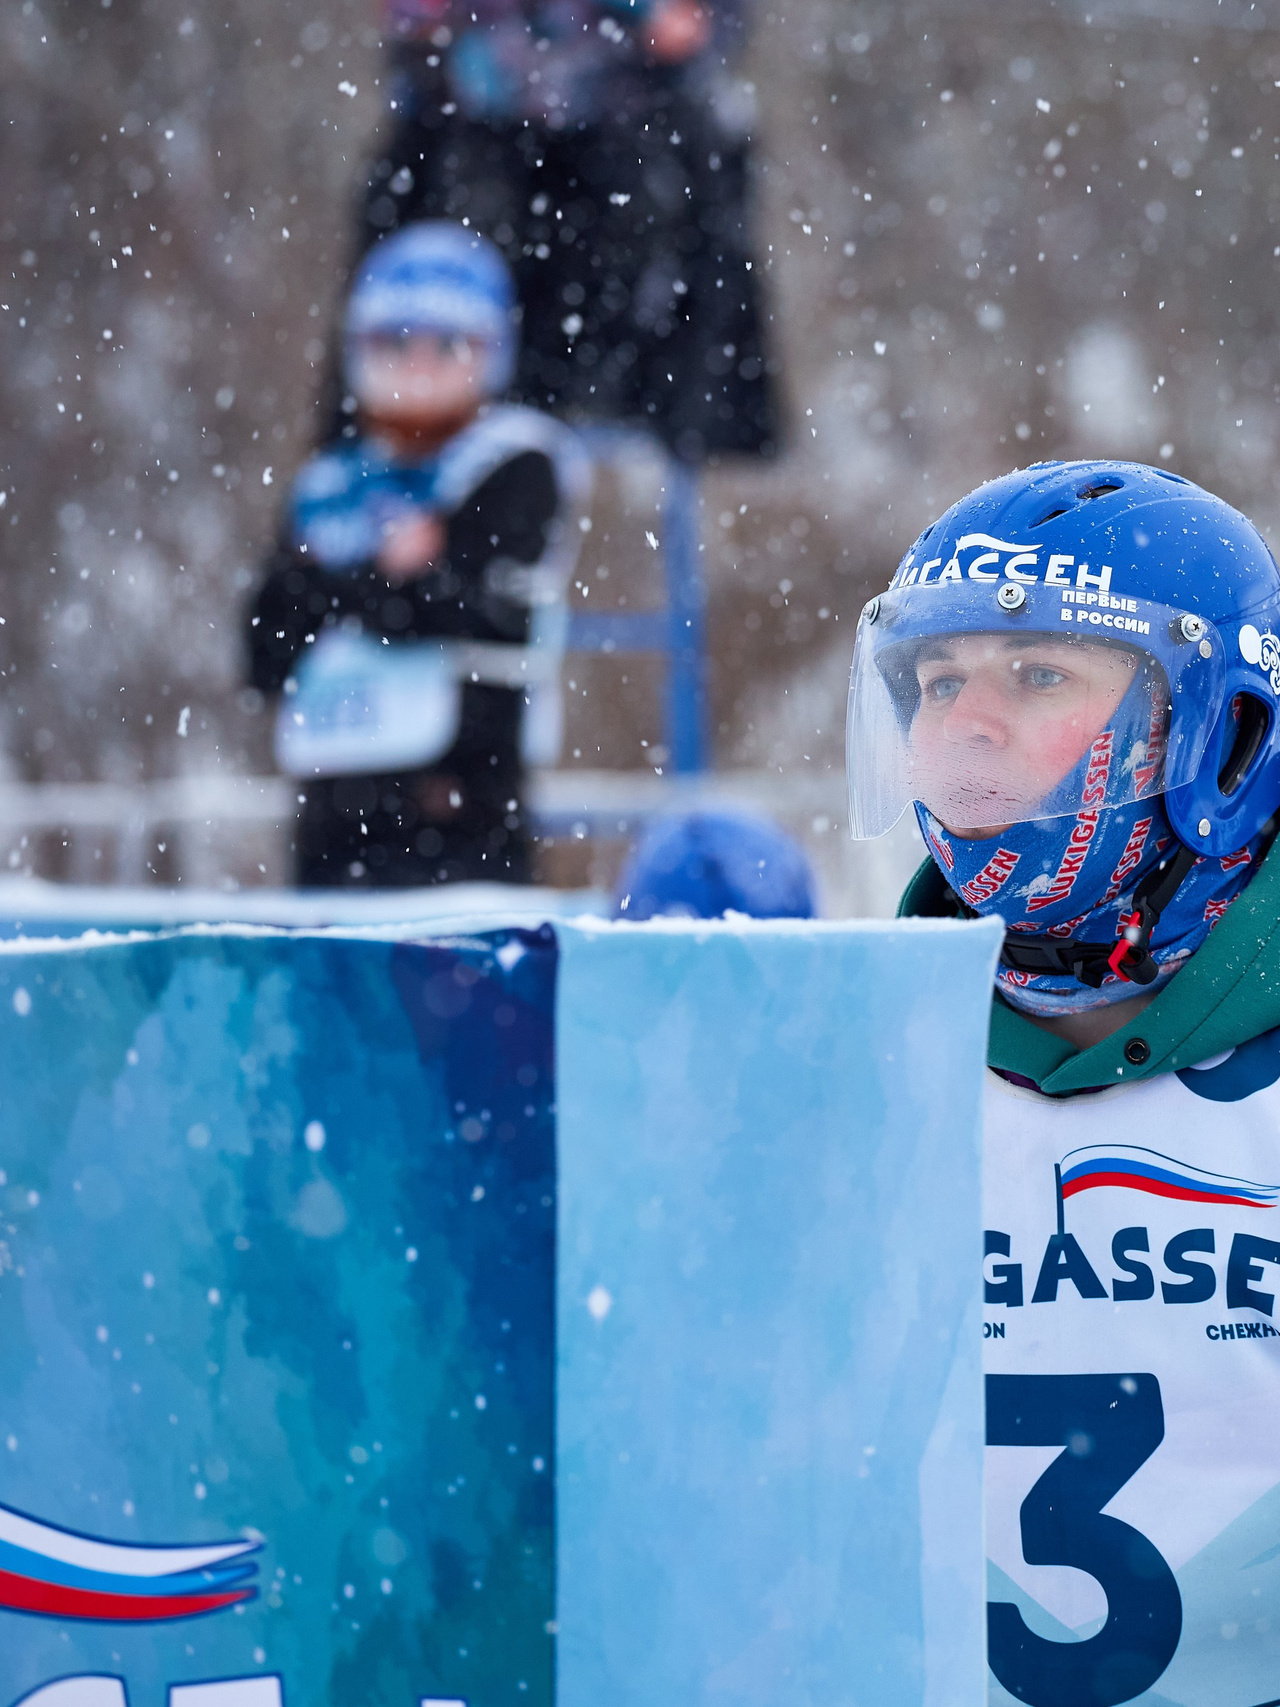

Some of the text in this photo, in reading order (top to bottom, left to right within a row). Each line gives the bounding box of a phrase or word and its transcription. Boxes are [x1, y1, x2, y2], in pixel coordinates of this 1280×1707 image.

[1061, 590, 1138, 613] ПЕРВЫЕ
[1060, 608, 1151, 635] В РОССИИ
[1025, 729, 1115, 914] YUKIGASSEN
